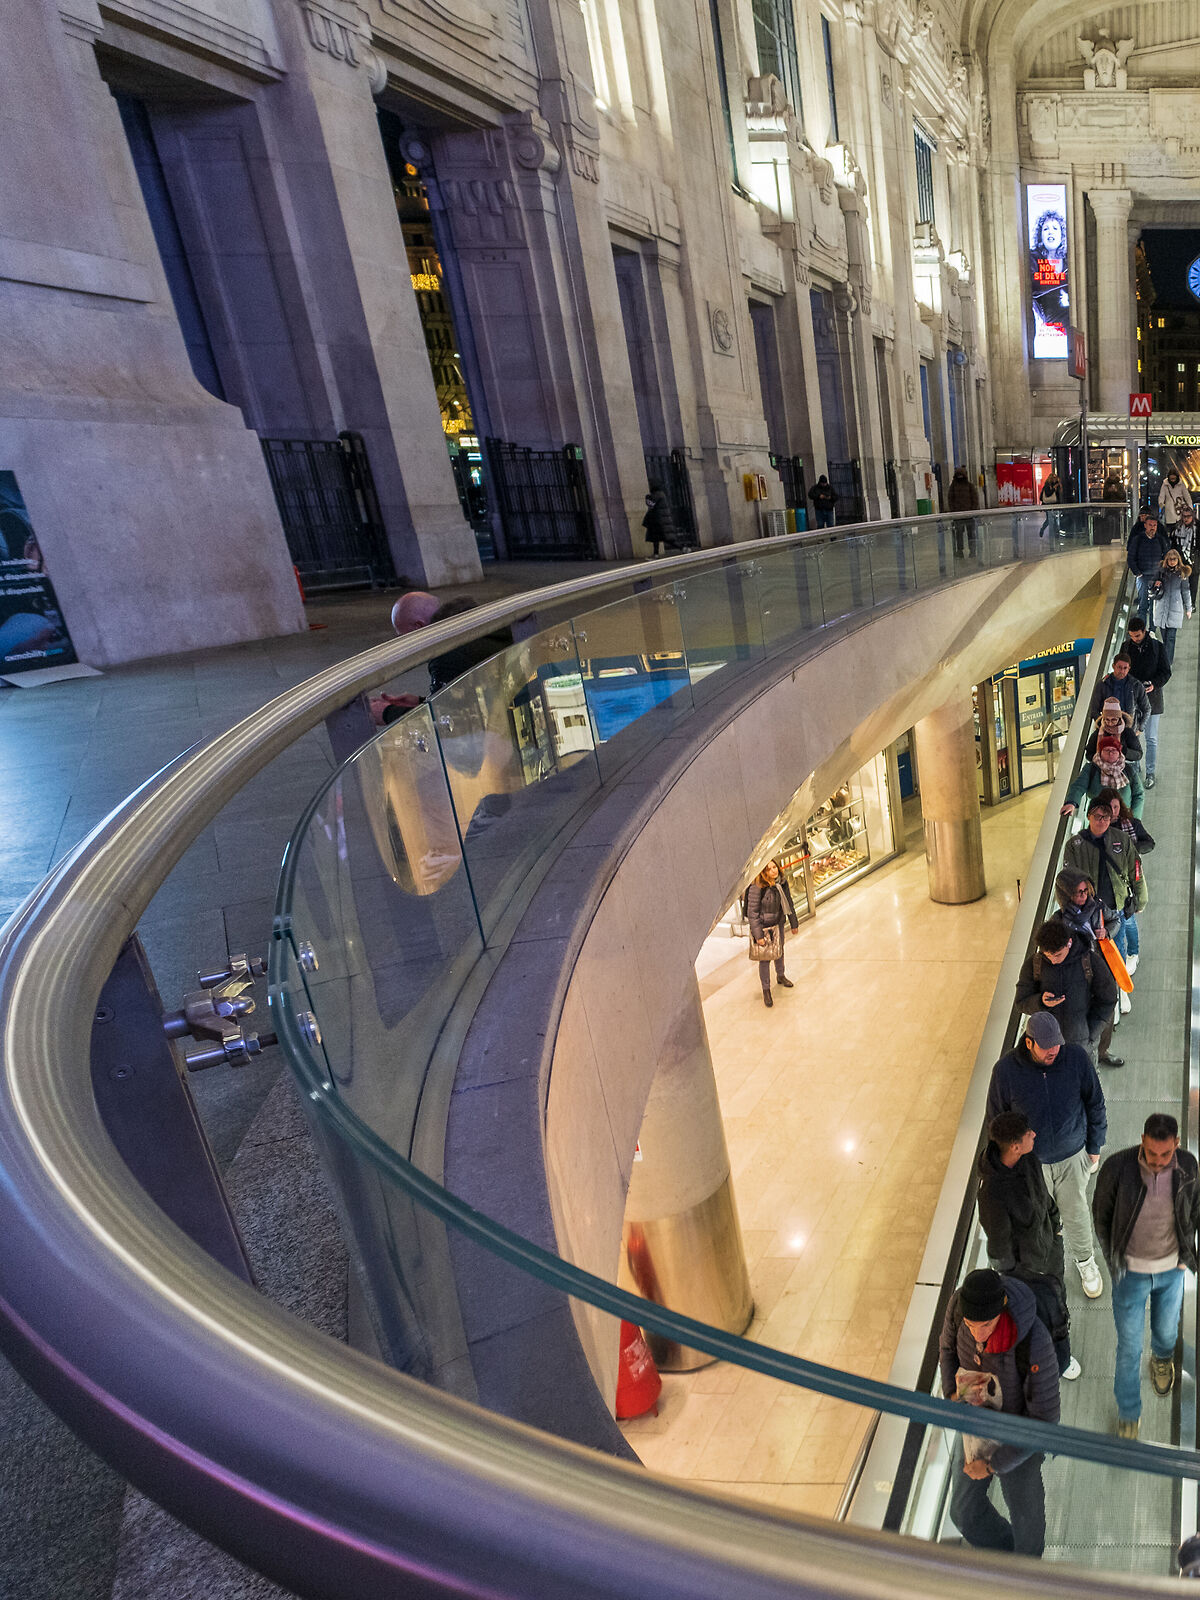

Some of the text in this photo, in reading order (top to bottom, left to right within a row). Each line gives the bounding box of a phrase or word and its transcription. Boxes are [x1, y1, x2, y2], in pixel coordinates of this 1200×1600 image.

[1039, 264, 1056, 272] NON
[1034, 272, 1066, 280] SI DEVE
[1131, 397, 1151, 413] M
